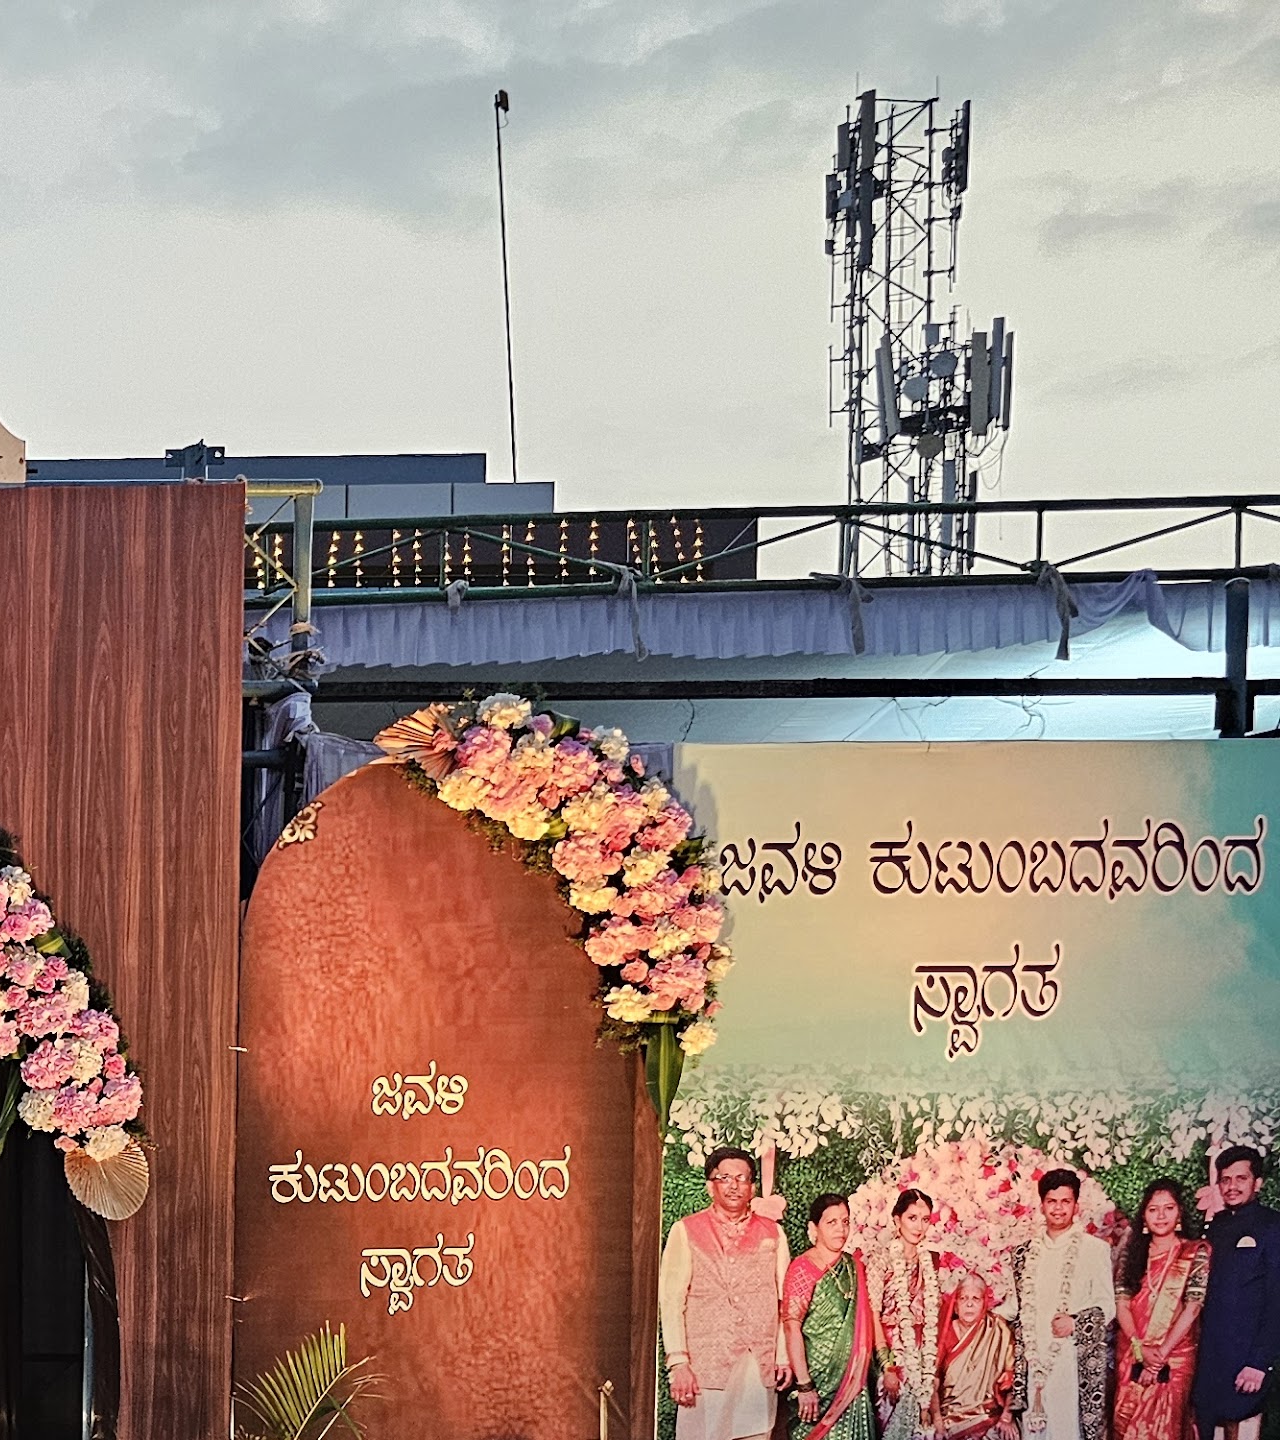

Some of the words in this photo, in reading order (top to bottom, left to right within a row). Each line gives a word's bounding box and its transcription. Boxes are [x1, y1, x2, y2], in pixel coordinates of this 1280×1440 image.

[719, 821, 842, 904] ಜವಳಿ
[870, 815, 1266, 900] ಕುಟುಂಬದವರಿಂದ
[914, 943, 1062, 1058] ಸ್ವಾಗತ
[371, 1060, 469, 1120] ಜವಳಿ
[268, 1145, 572, 1206] ಕುಟುಂಬದವರಿಂದ
[359, 1232, 475, 1315] ಸ್ವಾಗತ
